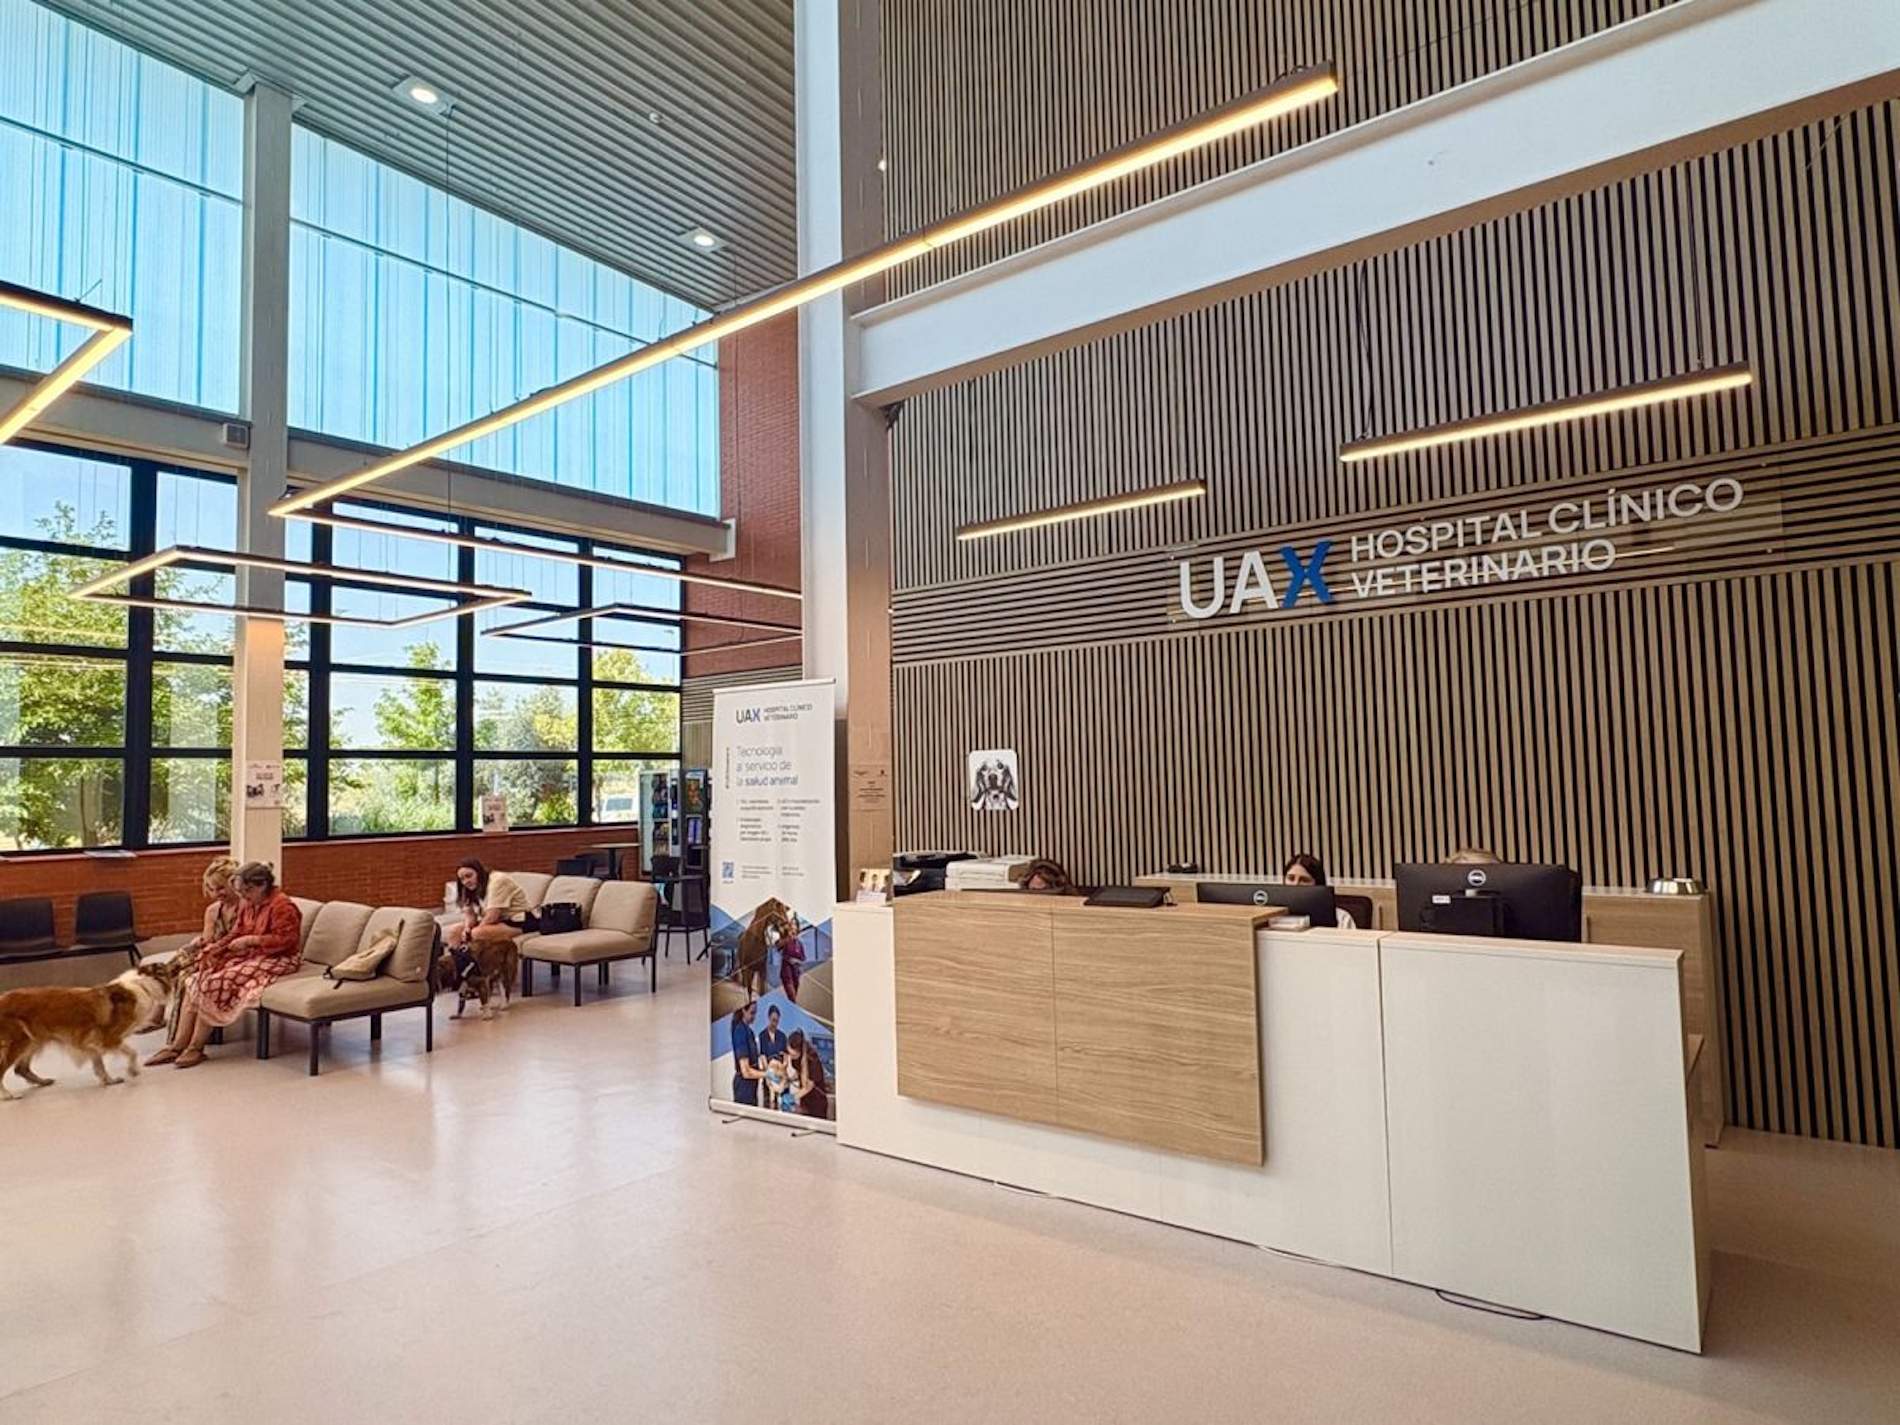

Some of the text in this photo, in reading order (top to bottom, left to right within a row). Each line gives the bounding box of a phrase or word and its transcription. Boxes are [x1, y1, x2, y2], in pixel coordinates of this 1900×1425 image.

[1351, 477, 1744, 562] HOSPITAL CLÍNICO
[1179, 540, 1334, 619] UAX
[1351, 538, 1616, 600] VETERINARIO
[736, 708, 761, 724] UAX
[745, 775, 768, 786] salud
[769, 774, 799, 785] animal
